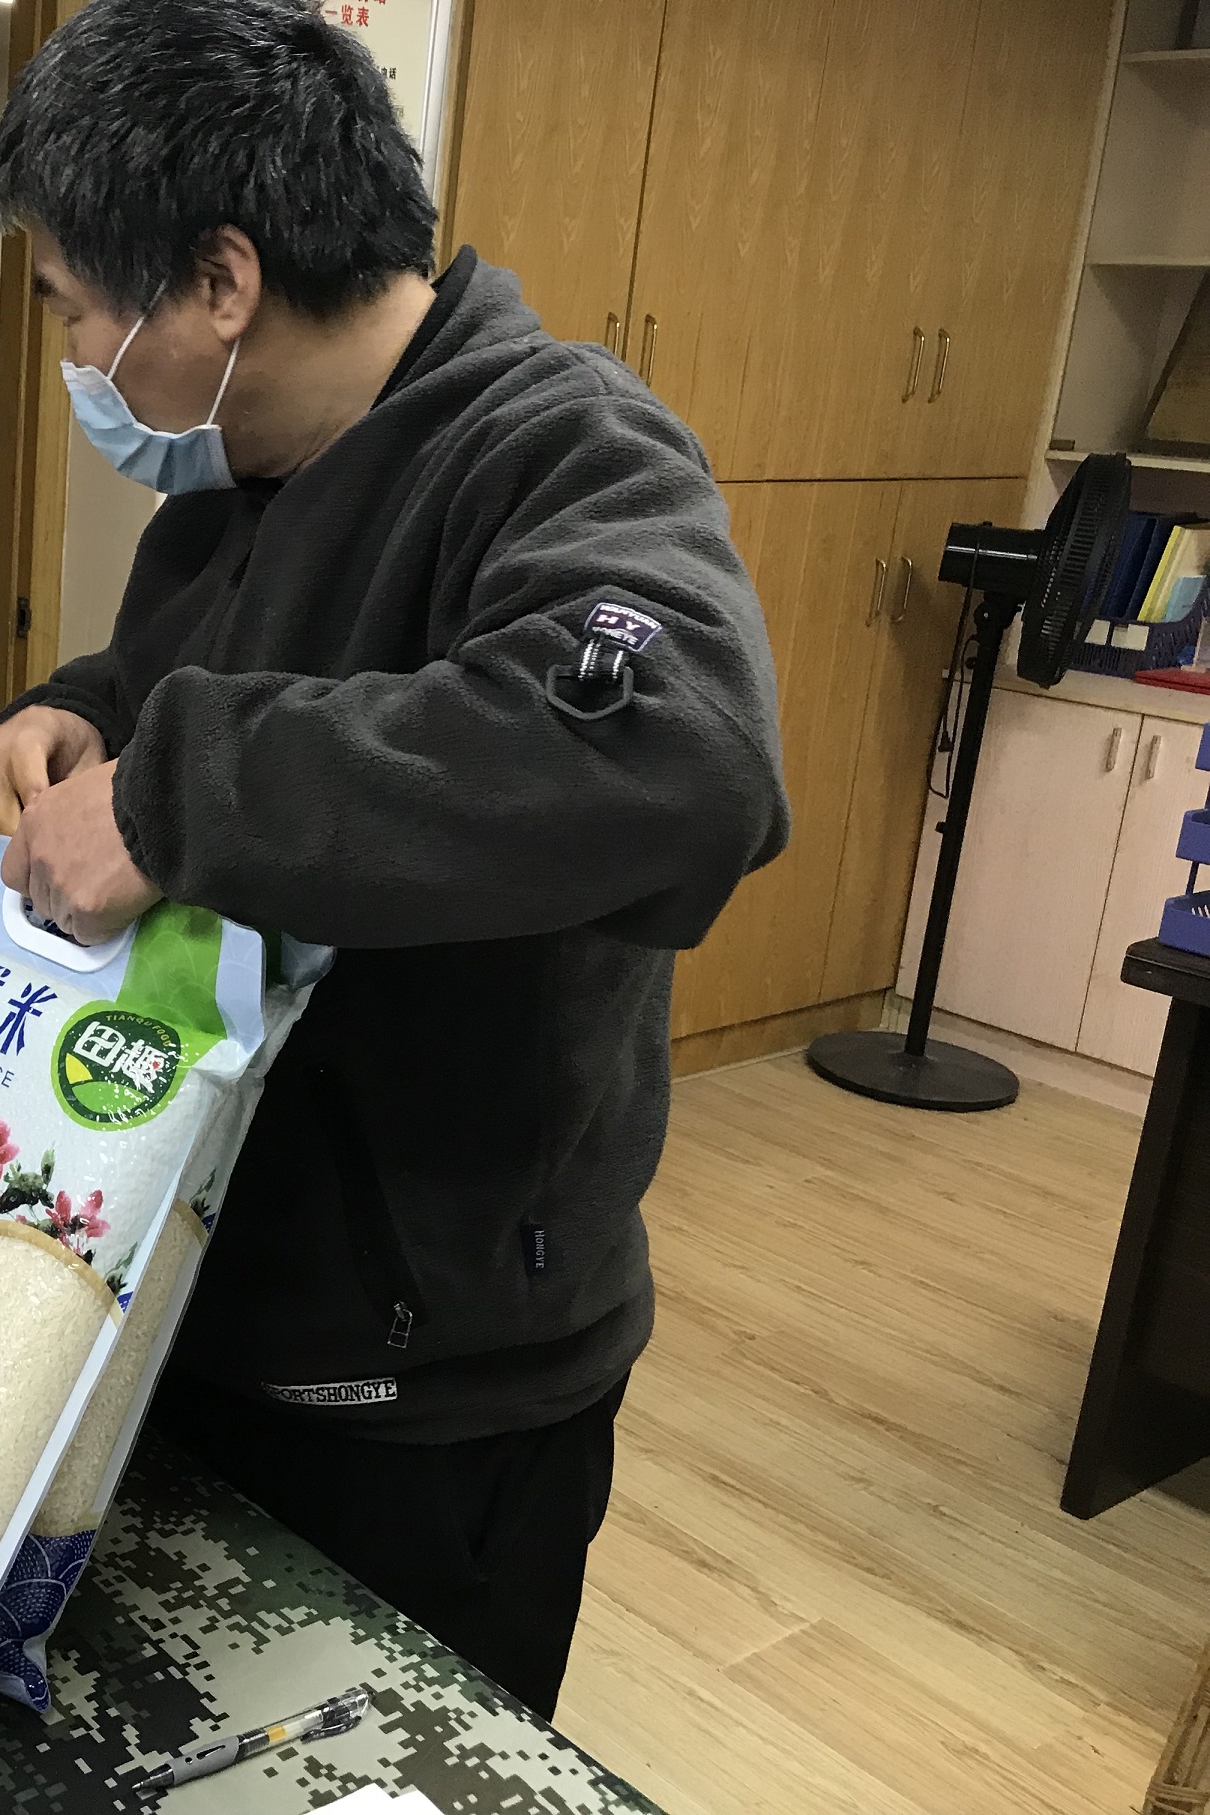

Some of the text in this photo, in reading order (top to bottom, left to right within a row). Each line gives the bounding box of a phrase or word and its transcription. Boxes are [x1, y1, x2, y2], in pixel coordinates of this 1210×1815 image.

[325, 5, 369, 27] 一览表
[106, 1014, 173, 1047] TIANQU FOOD
[534, 1229, 545, 1270] HONGYE
[272, 1380, 396, 1403] ORTSHONGYE
